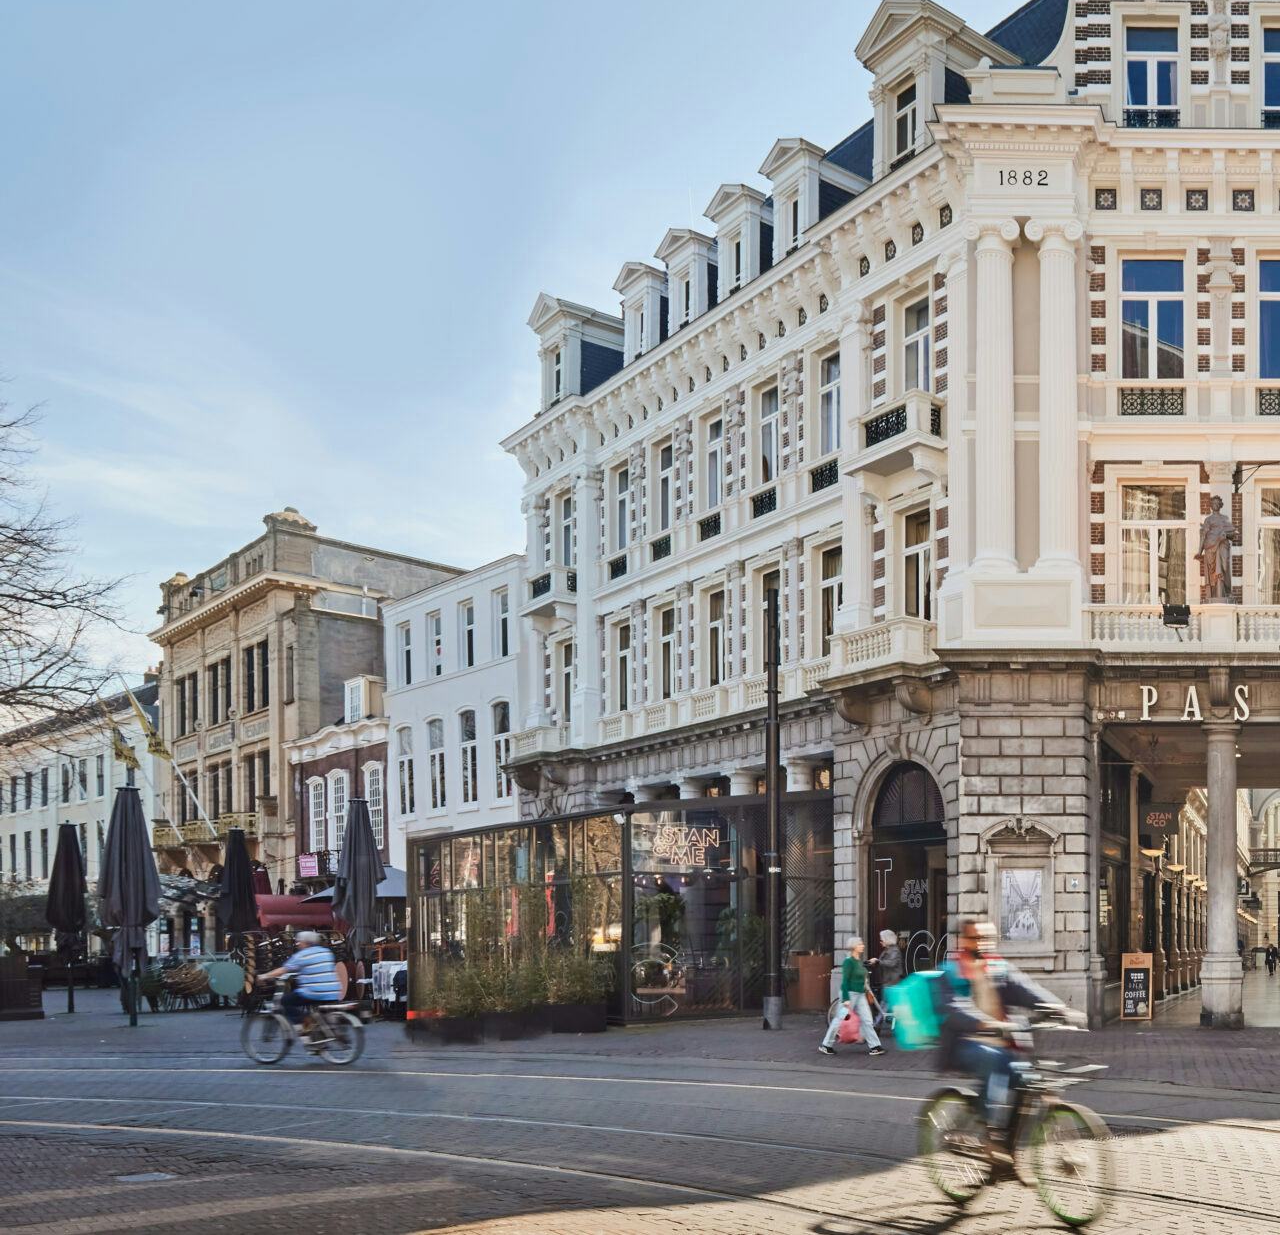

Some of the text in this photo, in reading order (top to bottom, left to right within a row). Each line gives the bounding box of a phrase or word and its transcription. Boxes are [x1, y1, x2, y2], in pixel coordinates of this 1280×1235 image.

[1000, 170, 1048, 186] 1882
[1150, 812, 1172, 820] STAN
[1153, 819, 1166, 827] CO
[661, 826, 720, 848] STAN
[671, 846, 706, 866] ME
[1124, 990, 1147, 999] COFFEE
